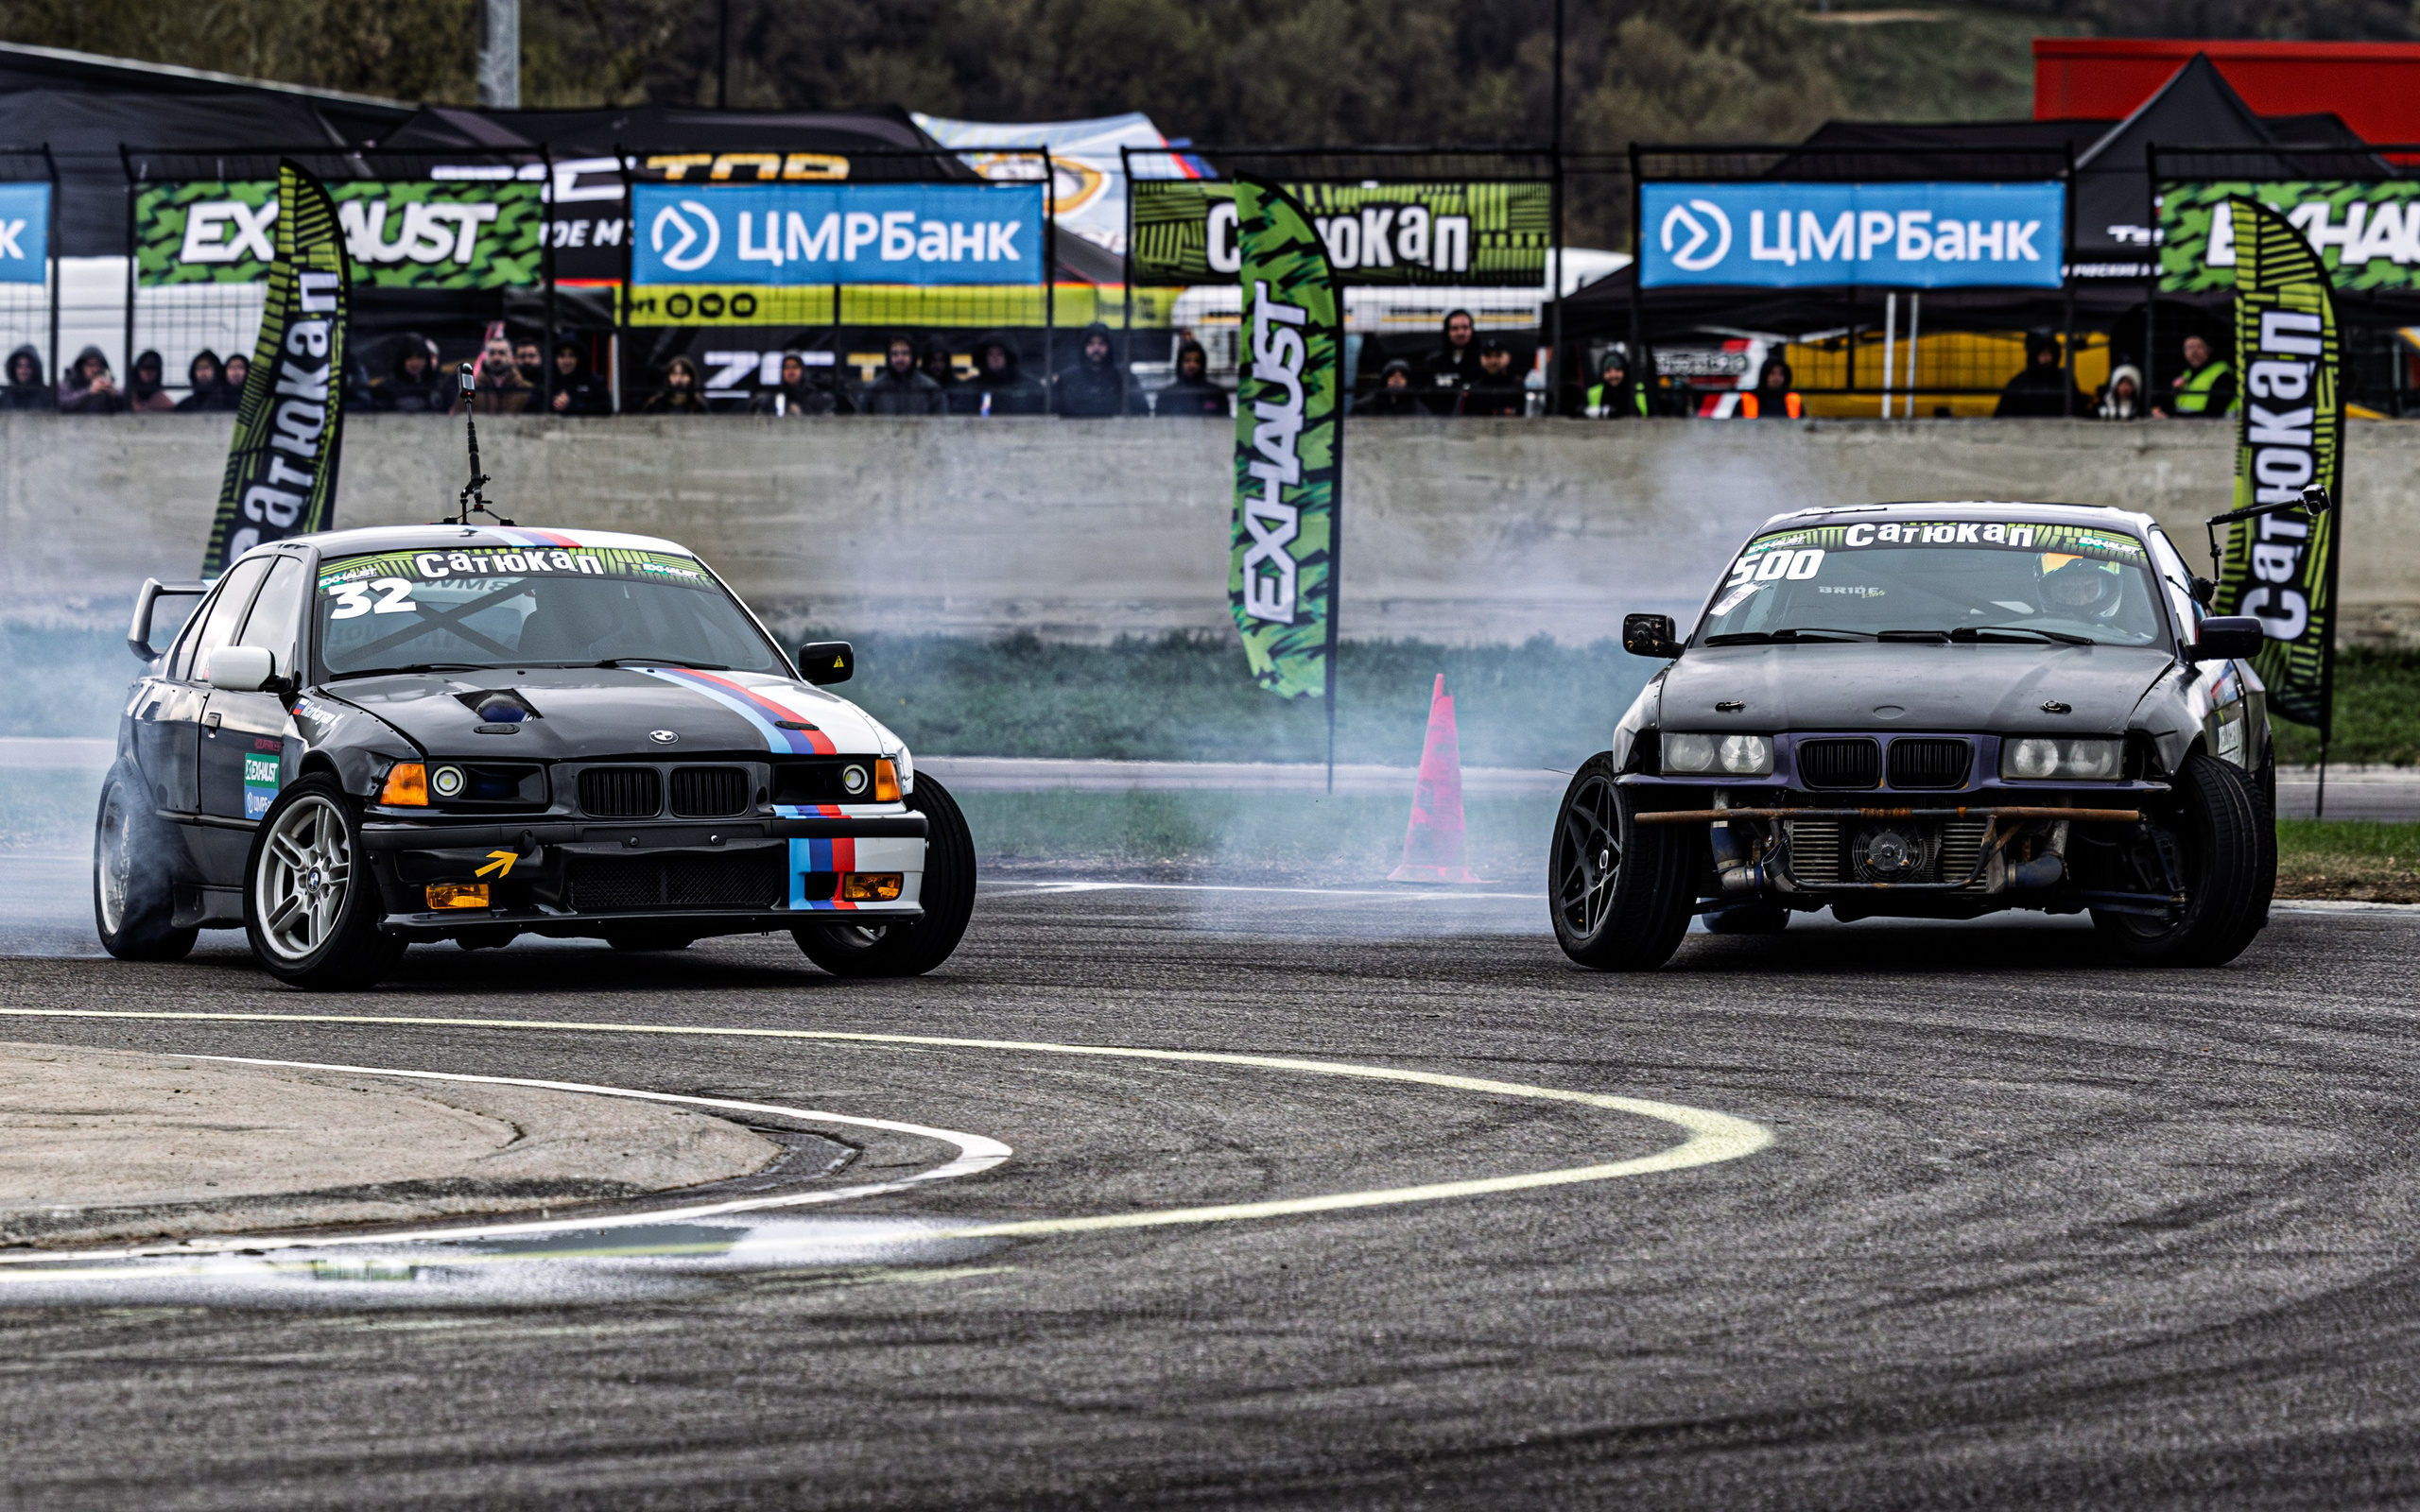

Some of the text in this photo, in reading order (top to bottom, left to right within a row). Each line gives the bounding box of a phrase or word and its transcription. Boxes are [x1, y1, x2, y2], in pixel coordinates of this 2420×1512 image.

[180, 199, 498, 264] EXAUST
[738, 211, 1022, 266] ЦМРБанк
[1207, 202, 1469, 273] Сюкап
[1750, 210, 2042, 266] ЦМРБанк
[1244, 280, 1307, 624] EXHAUST
[1725, 549, 1825, 588] 500
[328, 577, 417, 619] 32
